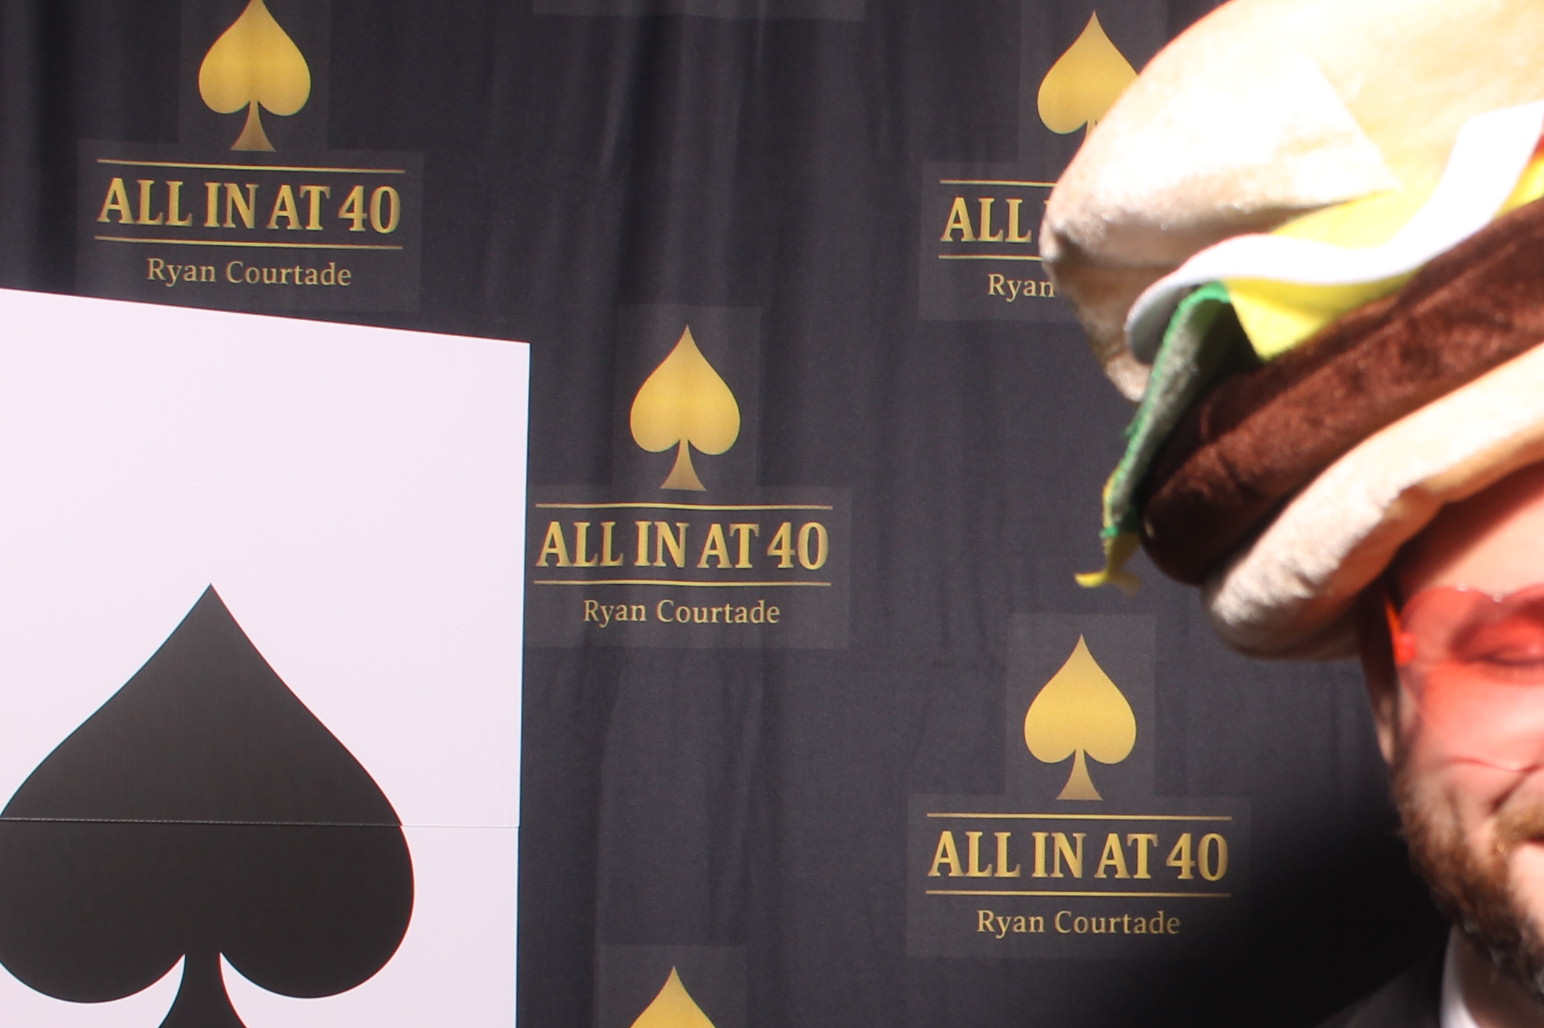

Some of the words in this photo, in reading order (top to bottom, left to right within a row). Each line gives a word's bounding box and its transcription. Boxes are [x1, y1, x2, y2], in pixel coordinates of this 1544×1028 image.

[97, 177, 193, 229] ALL
[203, 181, 258, 230] IN
[267, 184, 331, 232] AT
[338, 184, 401, 234] 40
[940, 197, 1032, 243] ALL
[147, 257, 217, 288] Ryan
[225, 260, 352, 287] Courtade
[987, 273, 1056, 302] Ryan
[536, 520, 624, 569] ALL
[634, 521, 689, 569] IN
[697, 522, 760, 570] AT
[766, 521, 829, 571] 40
[583, 599, 647, 628] Ryan
[655, 599, 781, 625] Courtade
[928, 830, 1021, 878] ALL
[1032, 831, 1086, 880] IN
[1094, 831, 1158, 881] AT
[1166, 832, 1228, 882] 40
[976, 909, 1045, 940] Ryan
[1054, 910, 1180, 935] Courtade
